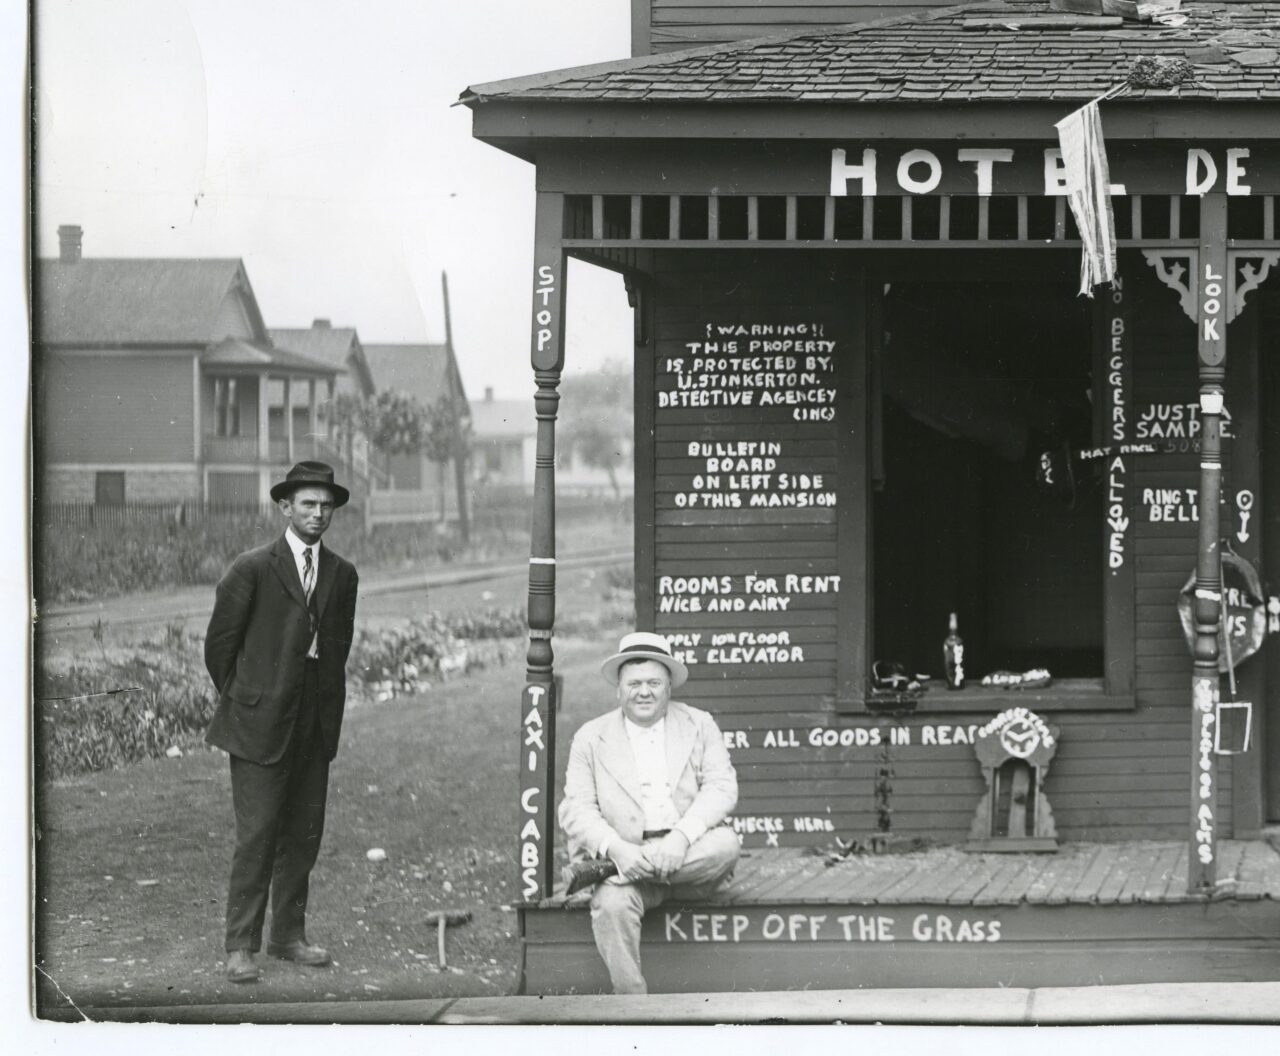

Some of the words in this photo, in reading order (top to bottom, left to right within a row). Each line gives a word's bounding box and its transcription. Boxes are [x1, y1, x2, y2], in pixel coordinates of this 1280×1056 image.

[1186, 149, 1251, 197] DE
[536, 266, 554, 351] STOP
[1204, 264, 1222, 340] LOOK
[686, 342, 737, 354] THIS
[750, 340, 835, 352] PROPERTY
[667, 359, 683, 372] IS
[693, 356, 796, 371] PROTECTED
[659, 390, 753, 407] DETECTIVE
[760, 389, 836, 405] AGENCEY
[1142, 404, 1200, 422] JUST
[688, 442, 780, 456] BULLETIN
[707, 458, 775, 472] BOARD
[693, 475, 719, 489] ON
[730, 475, 770, 489] LEFT
[779, 474, 822, 489] SIDE
[675, 493, 698, 507] OF
[702, 493, 741, 507] THIS
[750, 493, 836, 507] MANSION
[1144, 489, 1180, 505] RING
[660, 576, 731, 594] ROOMS
[745, 576, 778, 593] FOR
[786, 575, 840, 593] RENT
[708, 598, 745, 611] AND
[739, 631, 789, 645] FLOOR
[707, 647, 803, 663] ELEVATOR
[525, 687, 544, 771] TAXI
[764, 730, 799, 747] ALL
[809, 728, 880, 746] GOODS
[891, 727, 909, 744] IN
[521, 788, 540, 901] CABS
[666, 915, 749, 942] KEEP
[763, 915, 826, 940] OFF
[838, 915, 895, 940] THE
[913, 915, 1001, 941] GRASS
